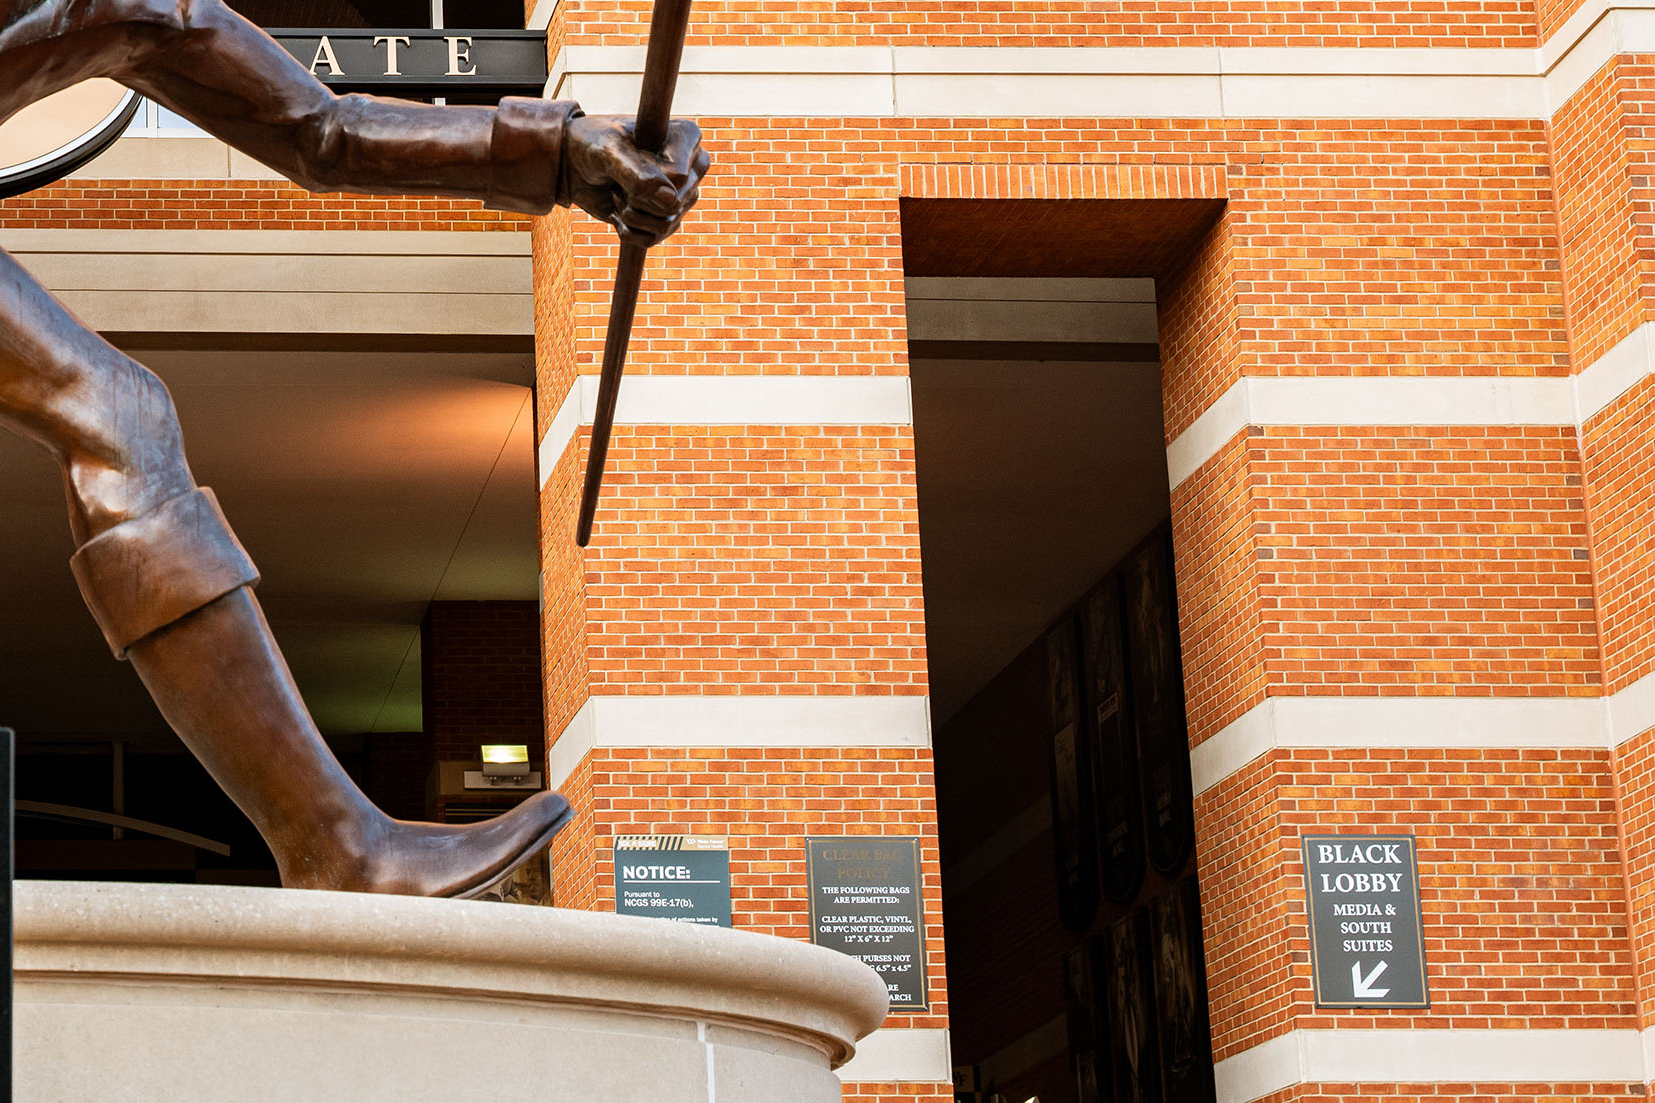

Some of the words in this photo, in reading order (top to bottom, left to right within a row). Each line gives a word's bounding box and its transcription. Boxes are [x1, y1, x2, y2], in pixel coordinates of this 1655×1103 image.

[309, 35, 477, 76] ATE
[1317, 844, 1402, 864] BLACK
[622, 865, 691, 880] NOTICE:
[1321, 873, 1403, 893] LOBBY
[822, 886, 839, 894] THE
[840, 886, 888, 894] FOLLOWING
[889, 886, 910, 894] BAGS
[624, 899, 649, 907] NCGS
[851, 896, 899, 904] PERMITTED:
[1333, 903, 1382, 916] MEDIA
[1384, 903, 1397, 916] &
[821, 915, 848, 923] CLEAR
[849, 915, 884, 924] PLASTIC,
[884, 915, 912, 924] VINYL,
[819, 925, 832, 933] OR
[833, 925, 849, 933] PVC
[850, 925, 868, 933] NOT
[869, 925, 915, 933] EXCEEDING
[1340, 921, 1392, 934] SOUTH
[1343, 939, 1393, 952] SUITES
[863, 954, 892, 962] PURSES
[893, 954, 911, 962] NOT
